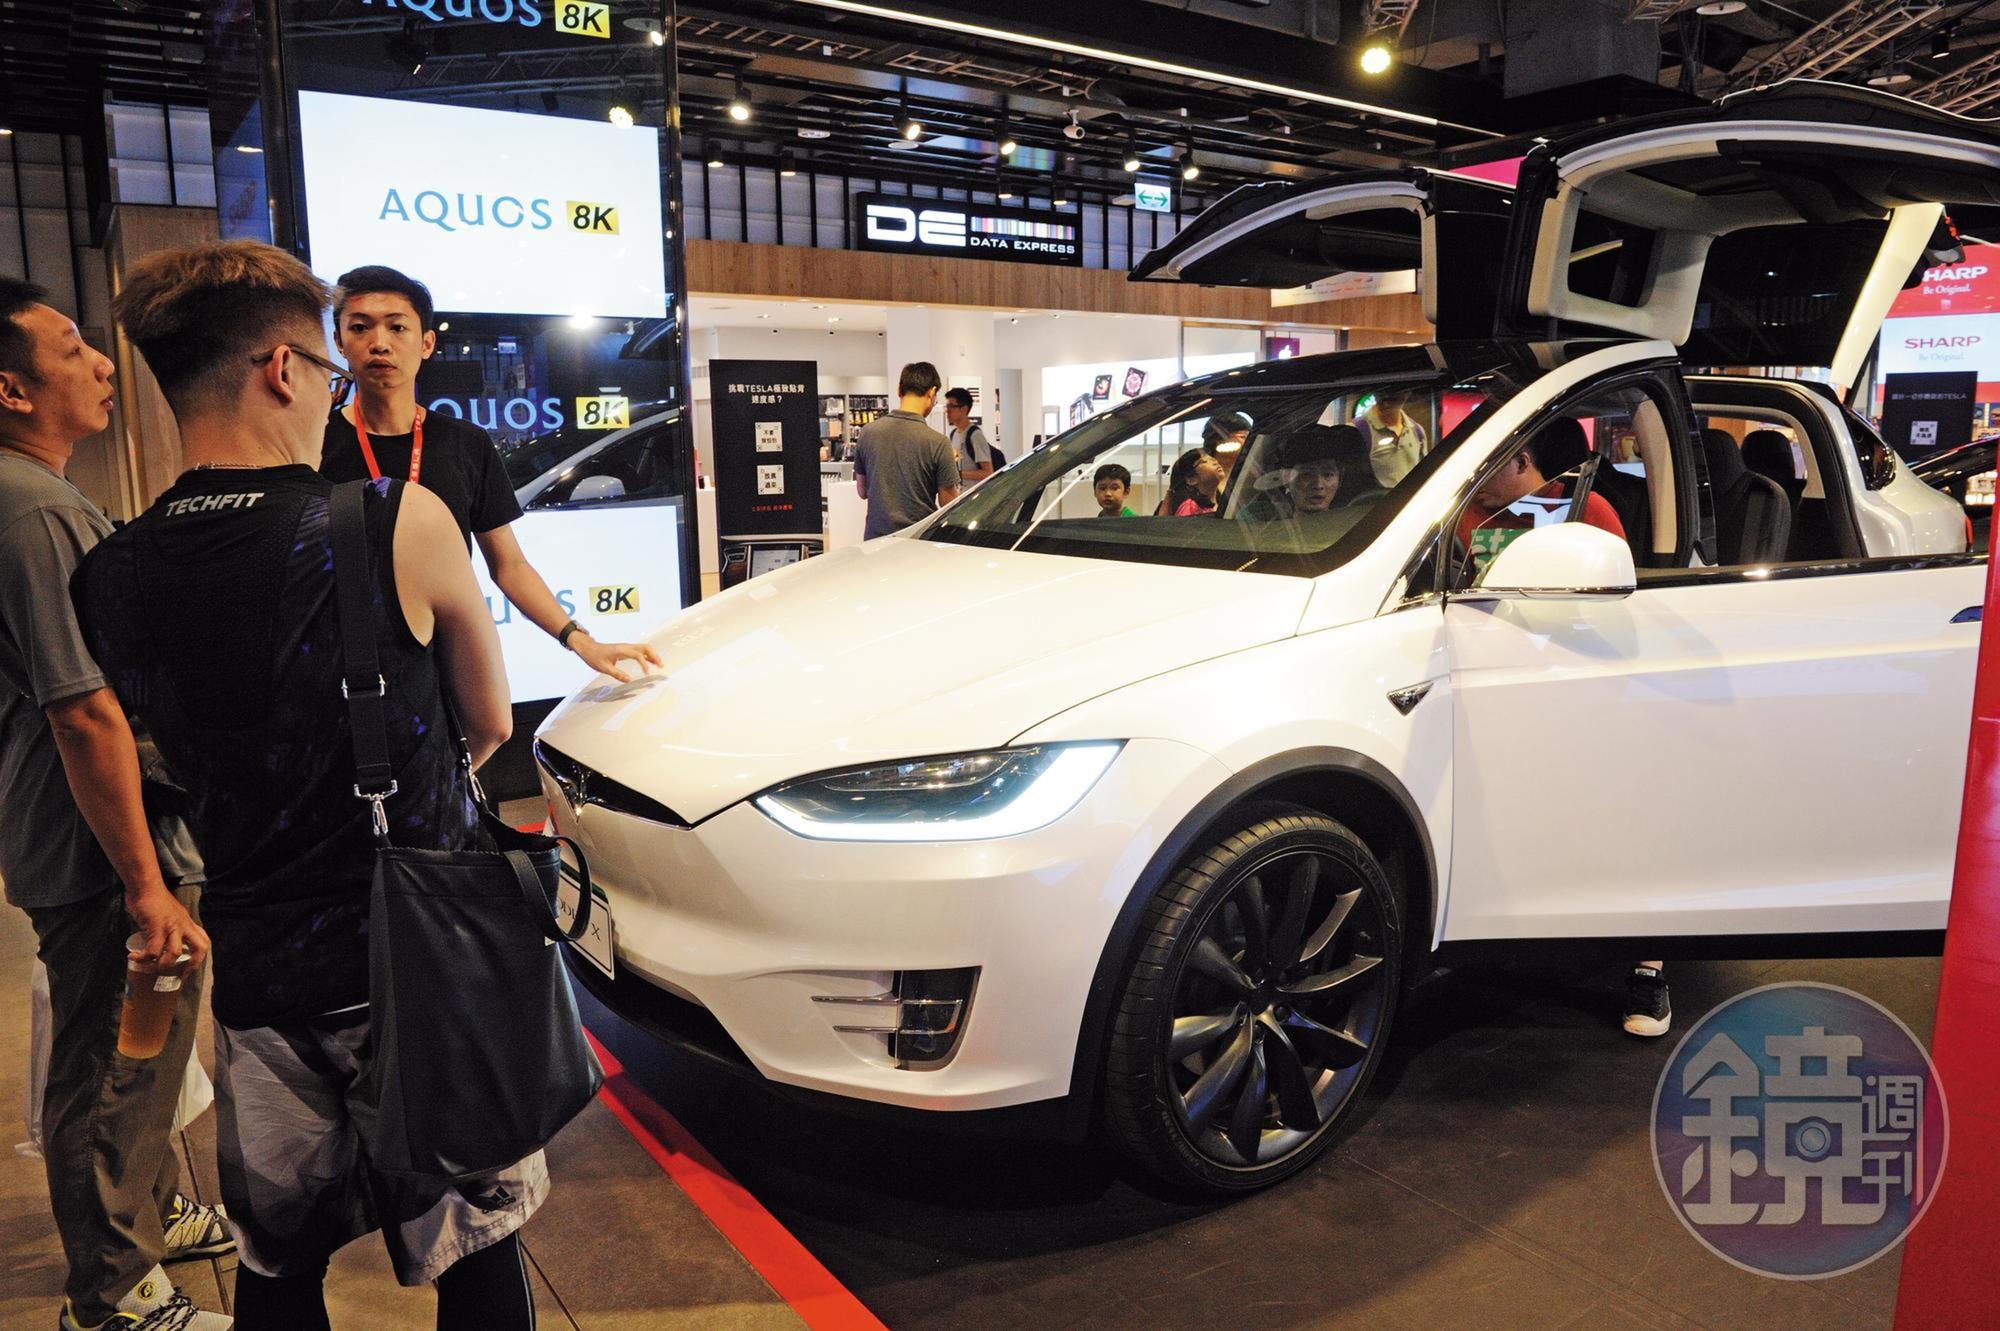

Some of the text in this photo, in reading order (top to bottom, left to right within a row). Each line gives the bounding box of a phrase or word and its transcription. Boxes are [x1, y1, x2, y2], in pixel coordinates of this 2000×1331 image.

[363, 0, 604, 33] QUOS 8K
[378, 188, 614, 232] AQUOS 8K
[866, 204, 966, 247] DE
[970, 236, 1075, 254] DATA EXPRESS
[1922, 266, 1988, 282] HARP
[1923, 286, 1934, 295] Be
[1904, 335, 1981, 349] SHARP
[584, 400, 624, 425] 8K
[166, 492, 265, 517] TECHFIT
[595, 587, 635, 613] 8K
